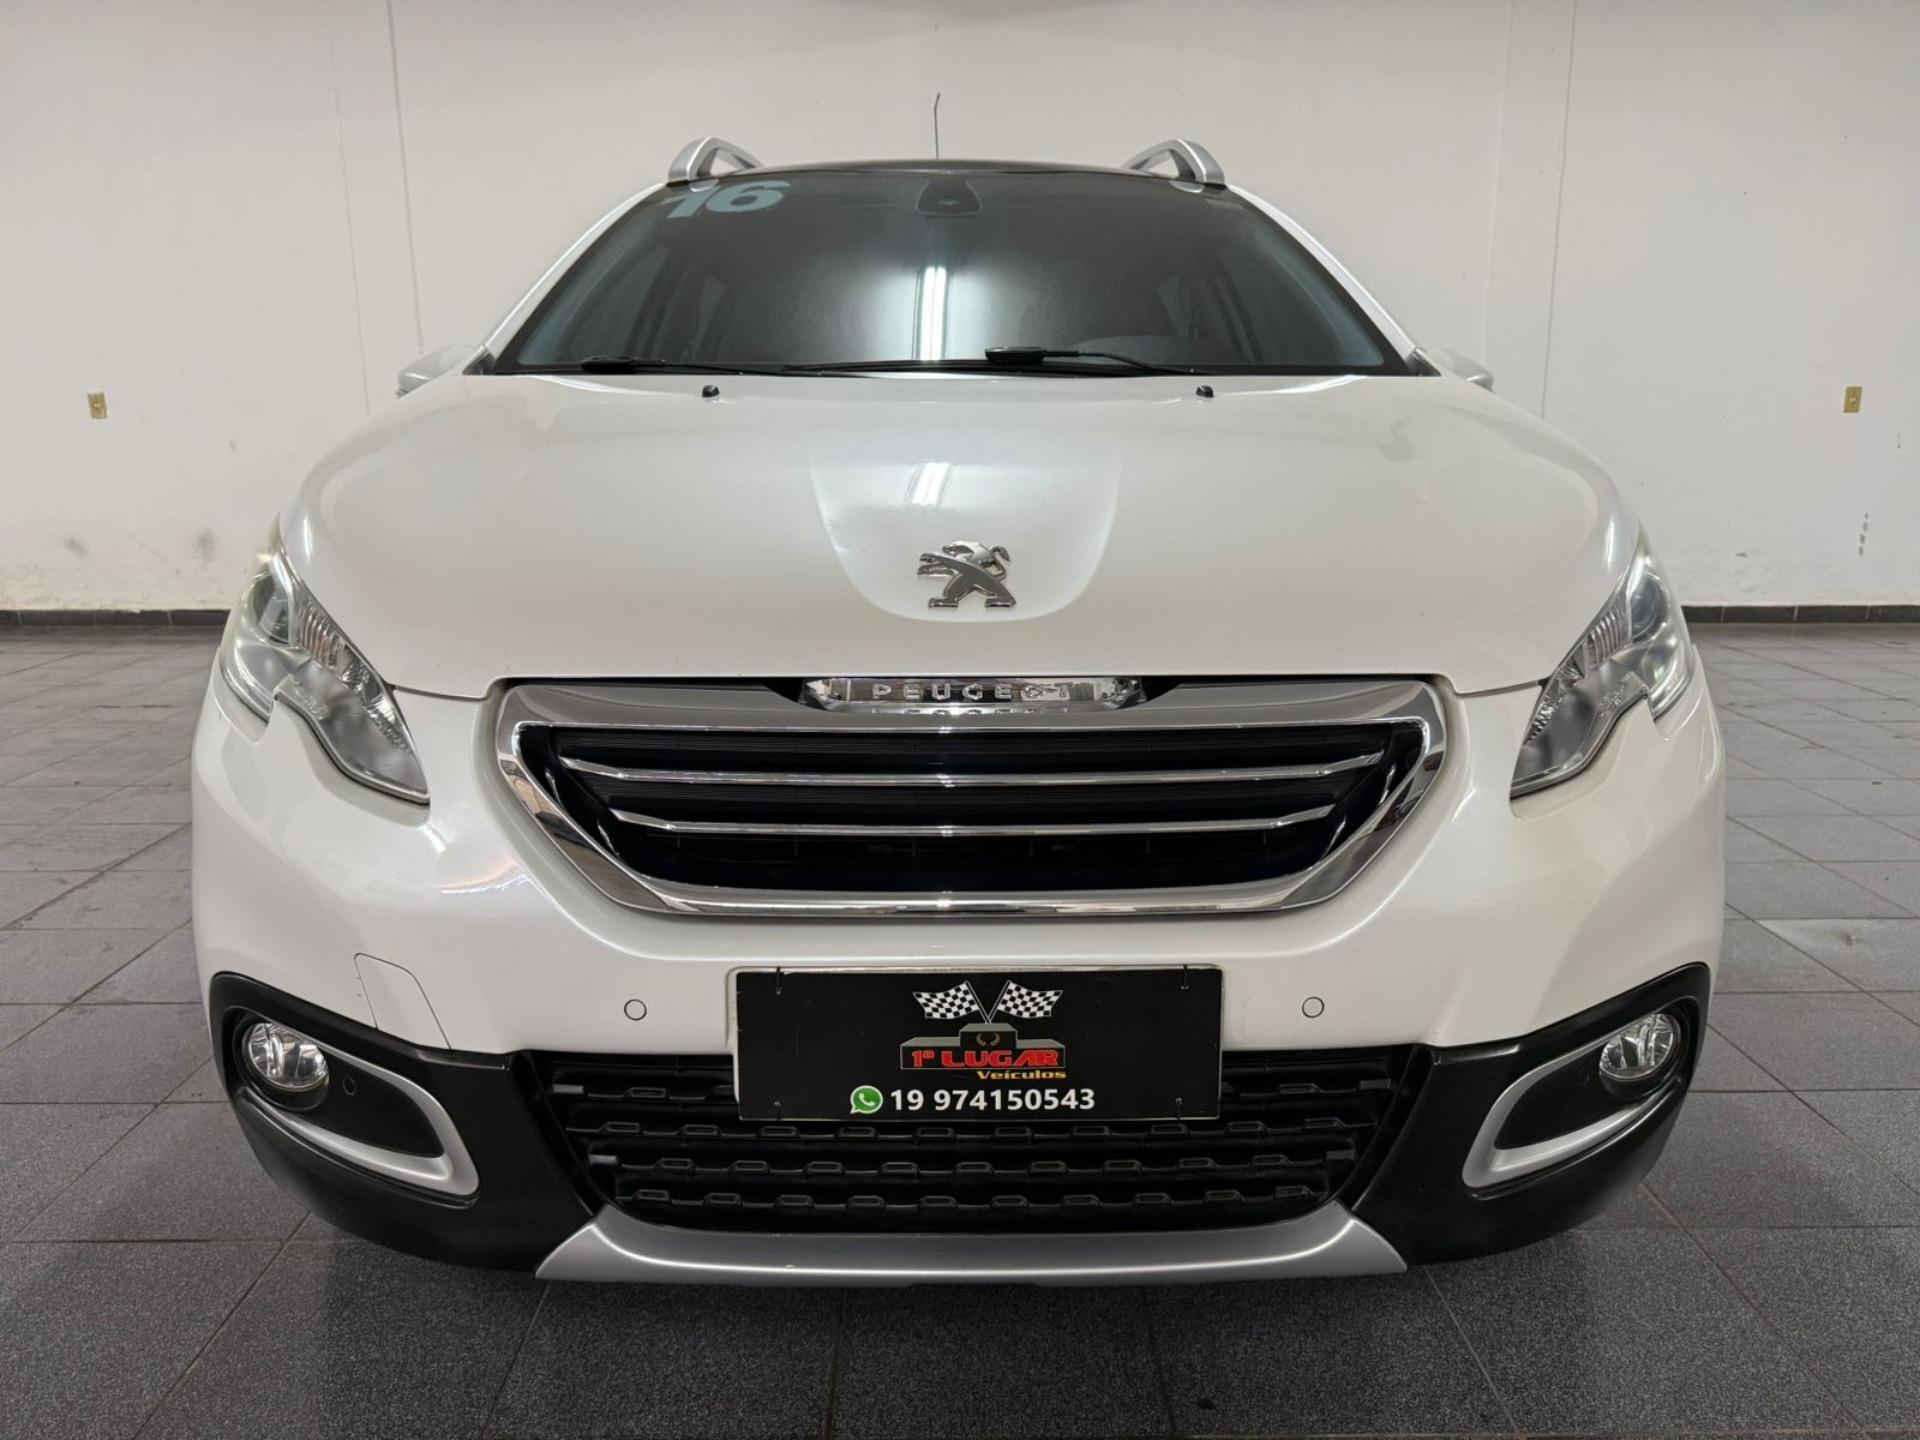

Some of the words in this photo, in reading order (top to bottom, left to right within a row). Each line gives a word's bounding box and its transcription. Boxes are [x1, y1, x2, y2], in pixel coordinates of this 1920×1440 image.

[660, 180, 791, 218] 16
[941, 1049, 1059, 1068] LUGAR
[890, 1088, 924, 1111] 19
[933, 1087, 1095, 1111] 974150543
